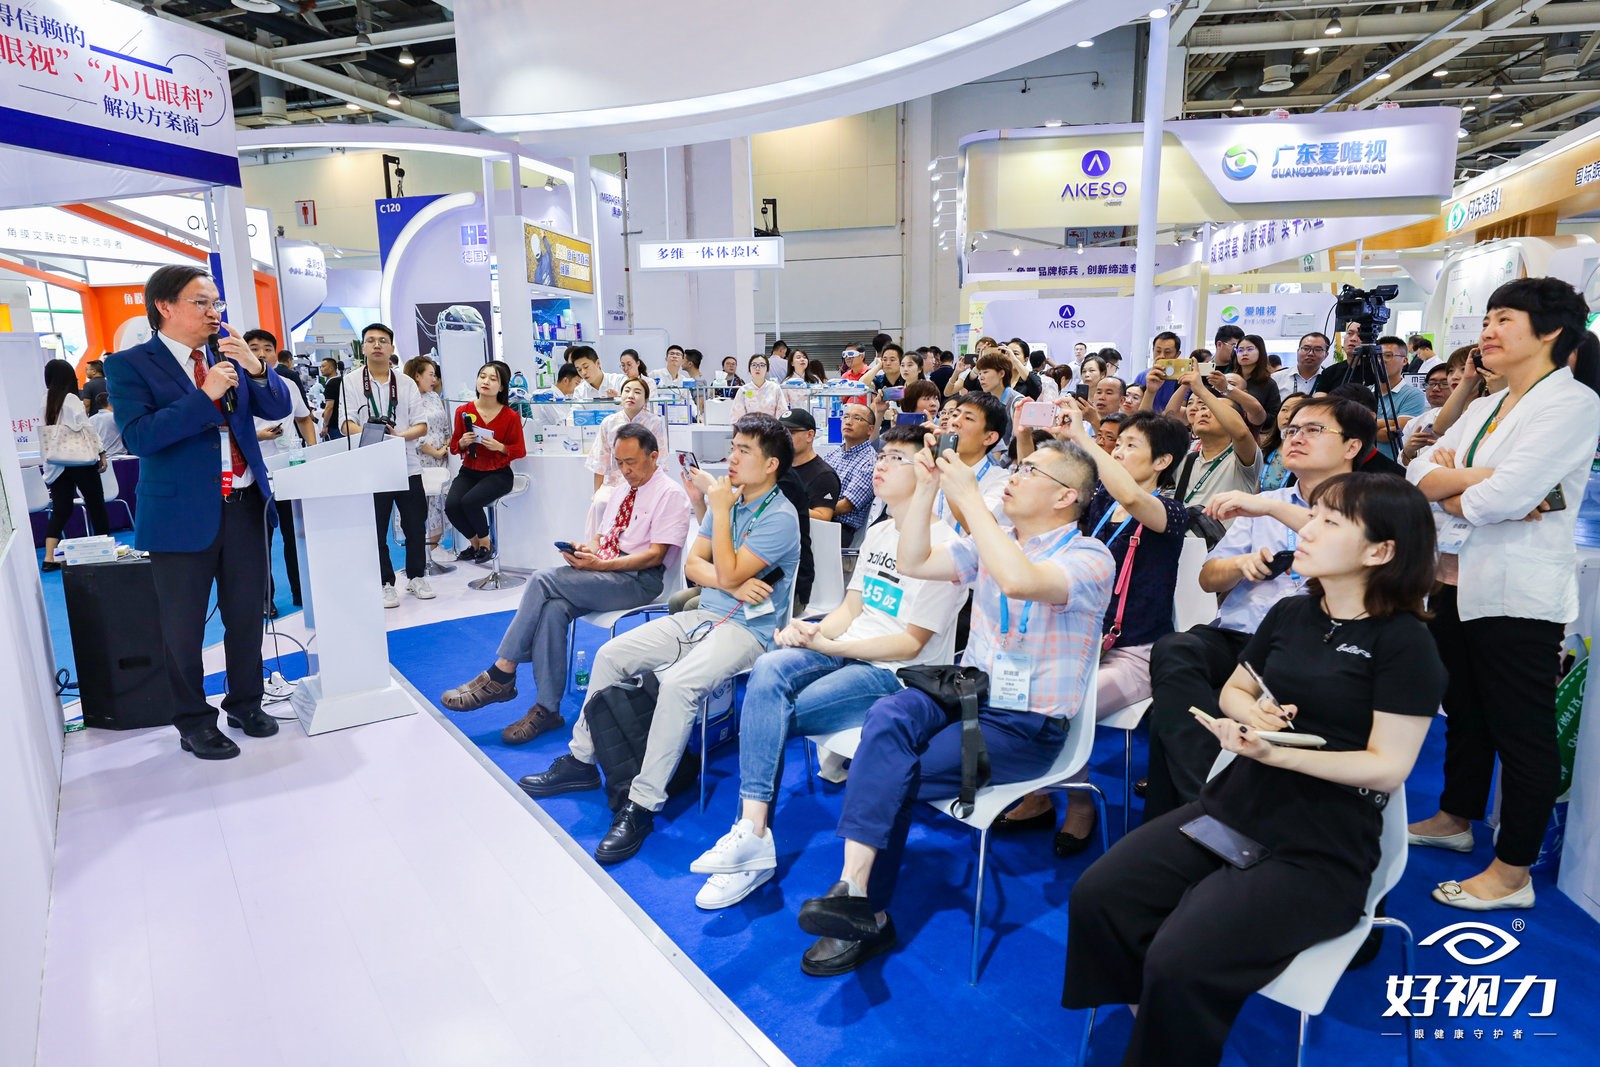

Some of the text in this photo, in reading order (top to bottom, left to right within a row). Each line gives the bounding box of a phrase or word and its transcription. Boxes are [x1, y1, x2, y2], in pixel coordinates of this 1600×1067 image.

[103, 95, 199, 136] 解决方案商
[1272, 140, 1387, 167] 广东爱唯视
[1061, 181, 1127, 198] AKESO
[380, 203, 401, 213] C120
[1093, 230, 1115, 239] 饮水处
[657, 244, 760, 260] 多维一体体验区
[1245, 306, 1277, 316] 爱唯视
[1049, 319, 1086, 329] AKESO
